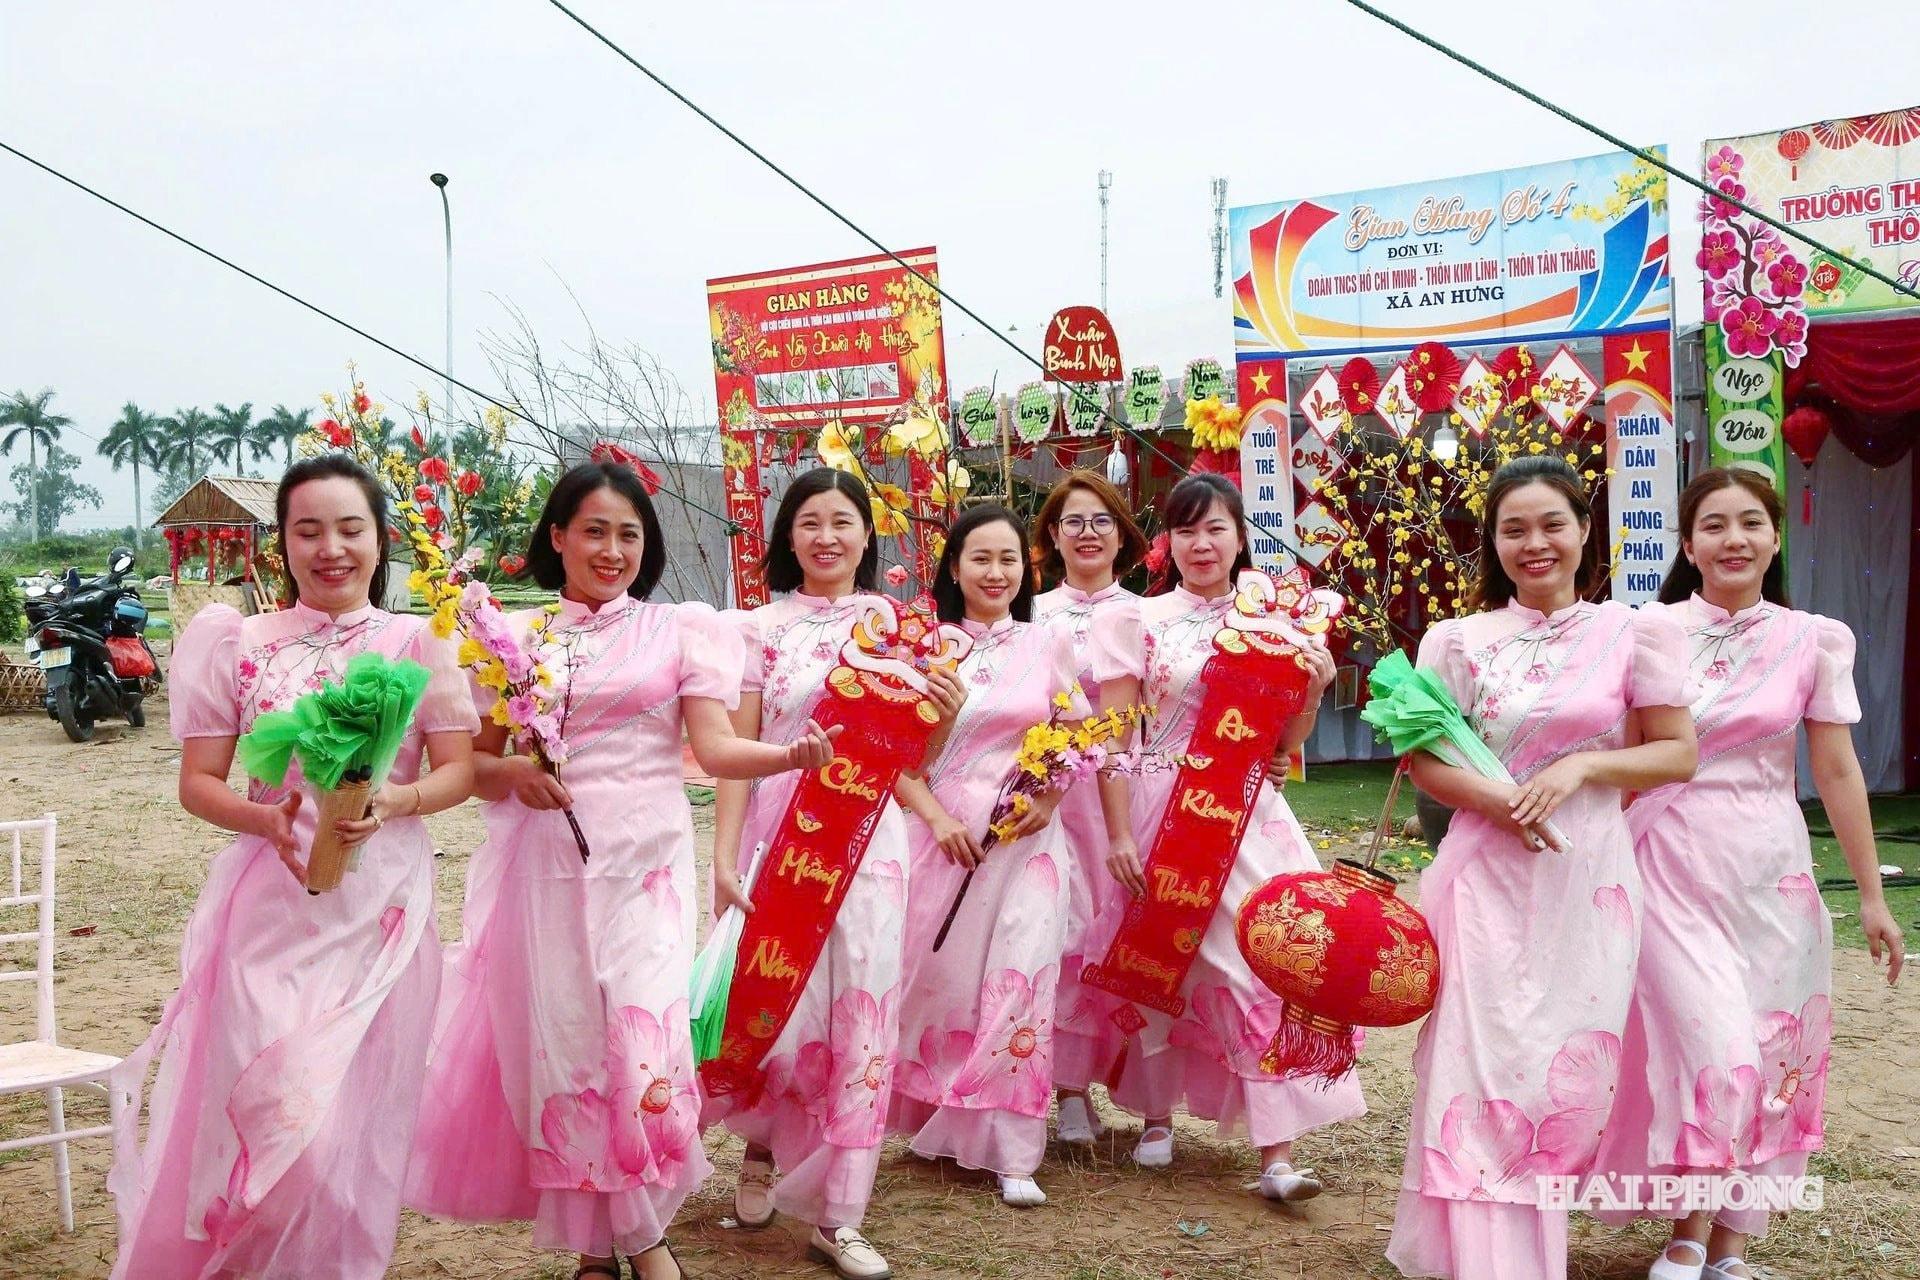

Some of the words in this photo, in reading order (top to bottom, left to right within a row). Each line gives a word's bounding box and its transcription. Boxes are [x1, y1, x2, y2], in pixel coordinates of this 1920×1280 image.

[1781, 183, 1881, 223] TRƯỜNG
[1345, 204, 1408, 251] Gian
[1502, 183, 1550, 231] Số
[1547, 181, 1577, 218] 4
[1387, 245, 1418, 258] ĐƠN
[1423, 242, 1443, 256] VỊ:
[1308, 274, 1332, 297] ĐOÀN
[1335, 275, 1357, 294] TNCS
[1360, 266, 1372, 292] HỒ
[1374, 267, 1389, 291] CHÍ
[1392, 268, 1417, 288] MINH
[1426, 261, 1451, 285] THÔN
[1454, 262, 1472, 284] KIM
[1508, 253, 1534, 278] THÔN
[1537, 250, 1557, 275] TÂN
[1560, 244, 1596, 272] THẮNG
[1815, 269, 1835, 287] Tết
[766, 291, 811, 313] GIAN
[815, 282, 870, 308] HÀNG
[1386, 292, 1413, 309] XÃ
[1419, 291, 1445, 307] AN
[1451, 285, 1505, 304] HƯNG
[1056, 316, 1107, 343] Xuân
[1045, 344, 1086, 371] Bính
[1089, 343, 1117, 377] Ngọ
[1132, 370, 1160, 389] Nam
[1190, 364, 1220, 387] Nam
[1722, 368, 1764, 396] Ngọ
[964, 408, 997, 424] Gian
[1619, 414, 1660, 436] NHÂN
[1252, 425, 1276, 449] TUỔI
[1722, 419, 1767, 442] Đón
[1255, 454, 1275, 475] TRẺ
[1625, 445, 1656, 467] DÂN
[1259, 485, 1274, 501] AN
[1631, 480, 1652, 498] AN
[1252, 510, 1283, 528] HƯNG
[1622, 509, 1663, 529] HƯNG
[1254, 538, 1284, 554] XUNG
[1623, 536, 1663, 560] PHẤN
[1215, 707, 1259, 742] An
[820, 757, 878, 801] Chúc
[1180, 787, 1243, 837] Khang
[778, 846, 842, 904] Mừng
[1153, 866, 1213, 909] Thịnh
[745, 938, 800, 992] Năm
